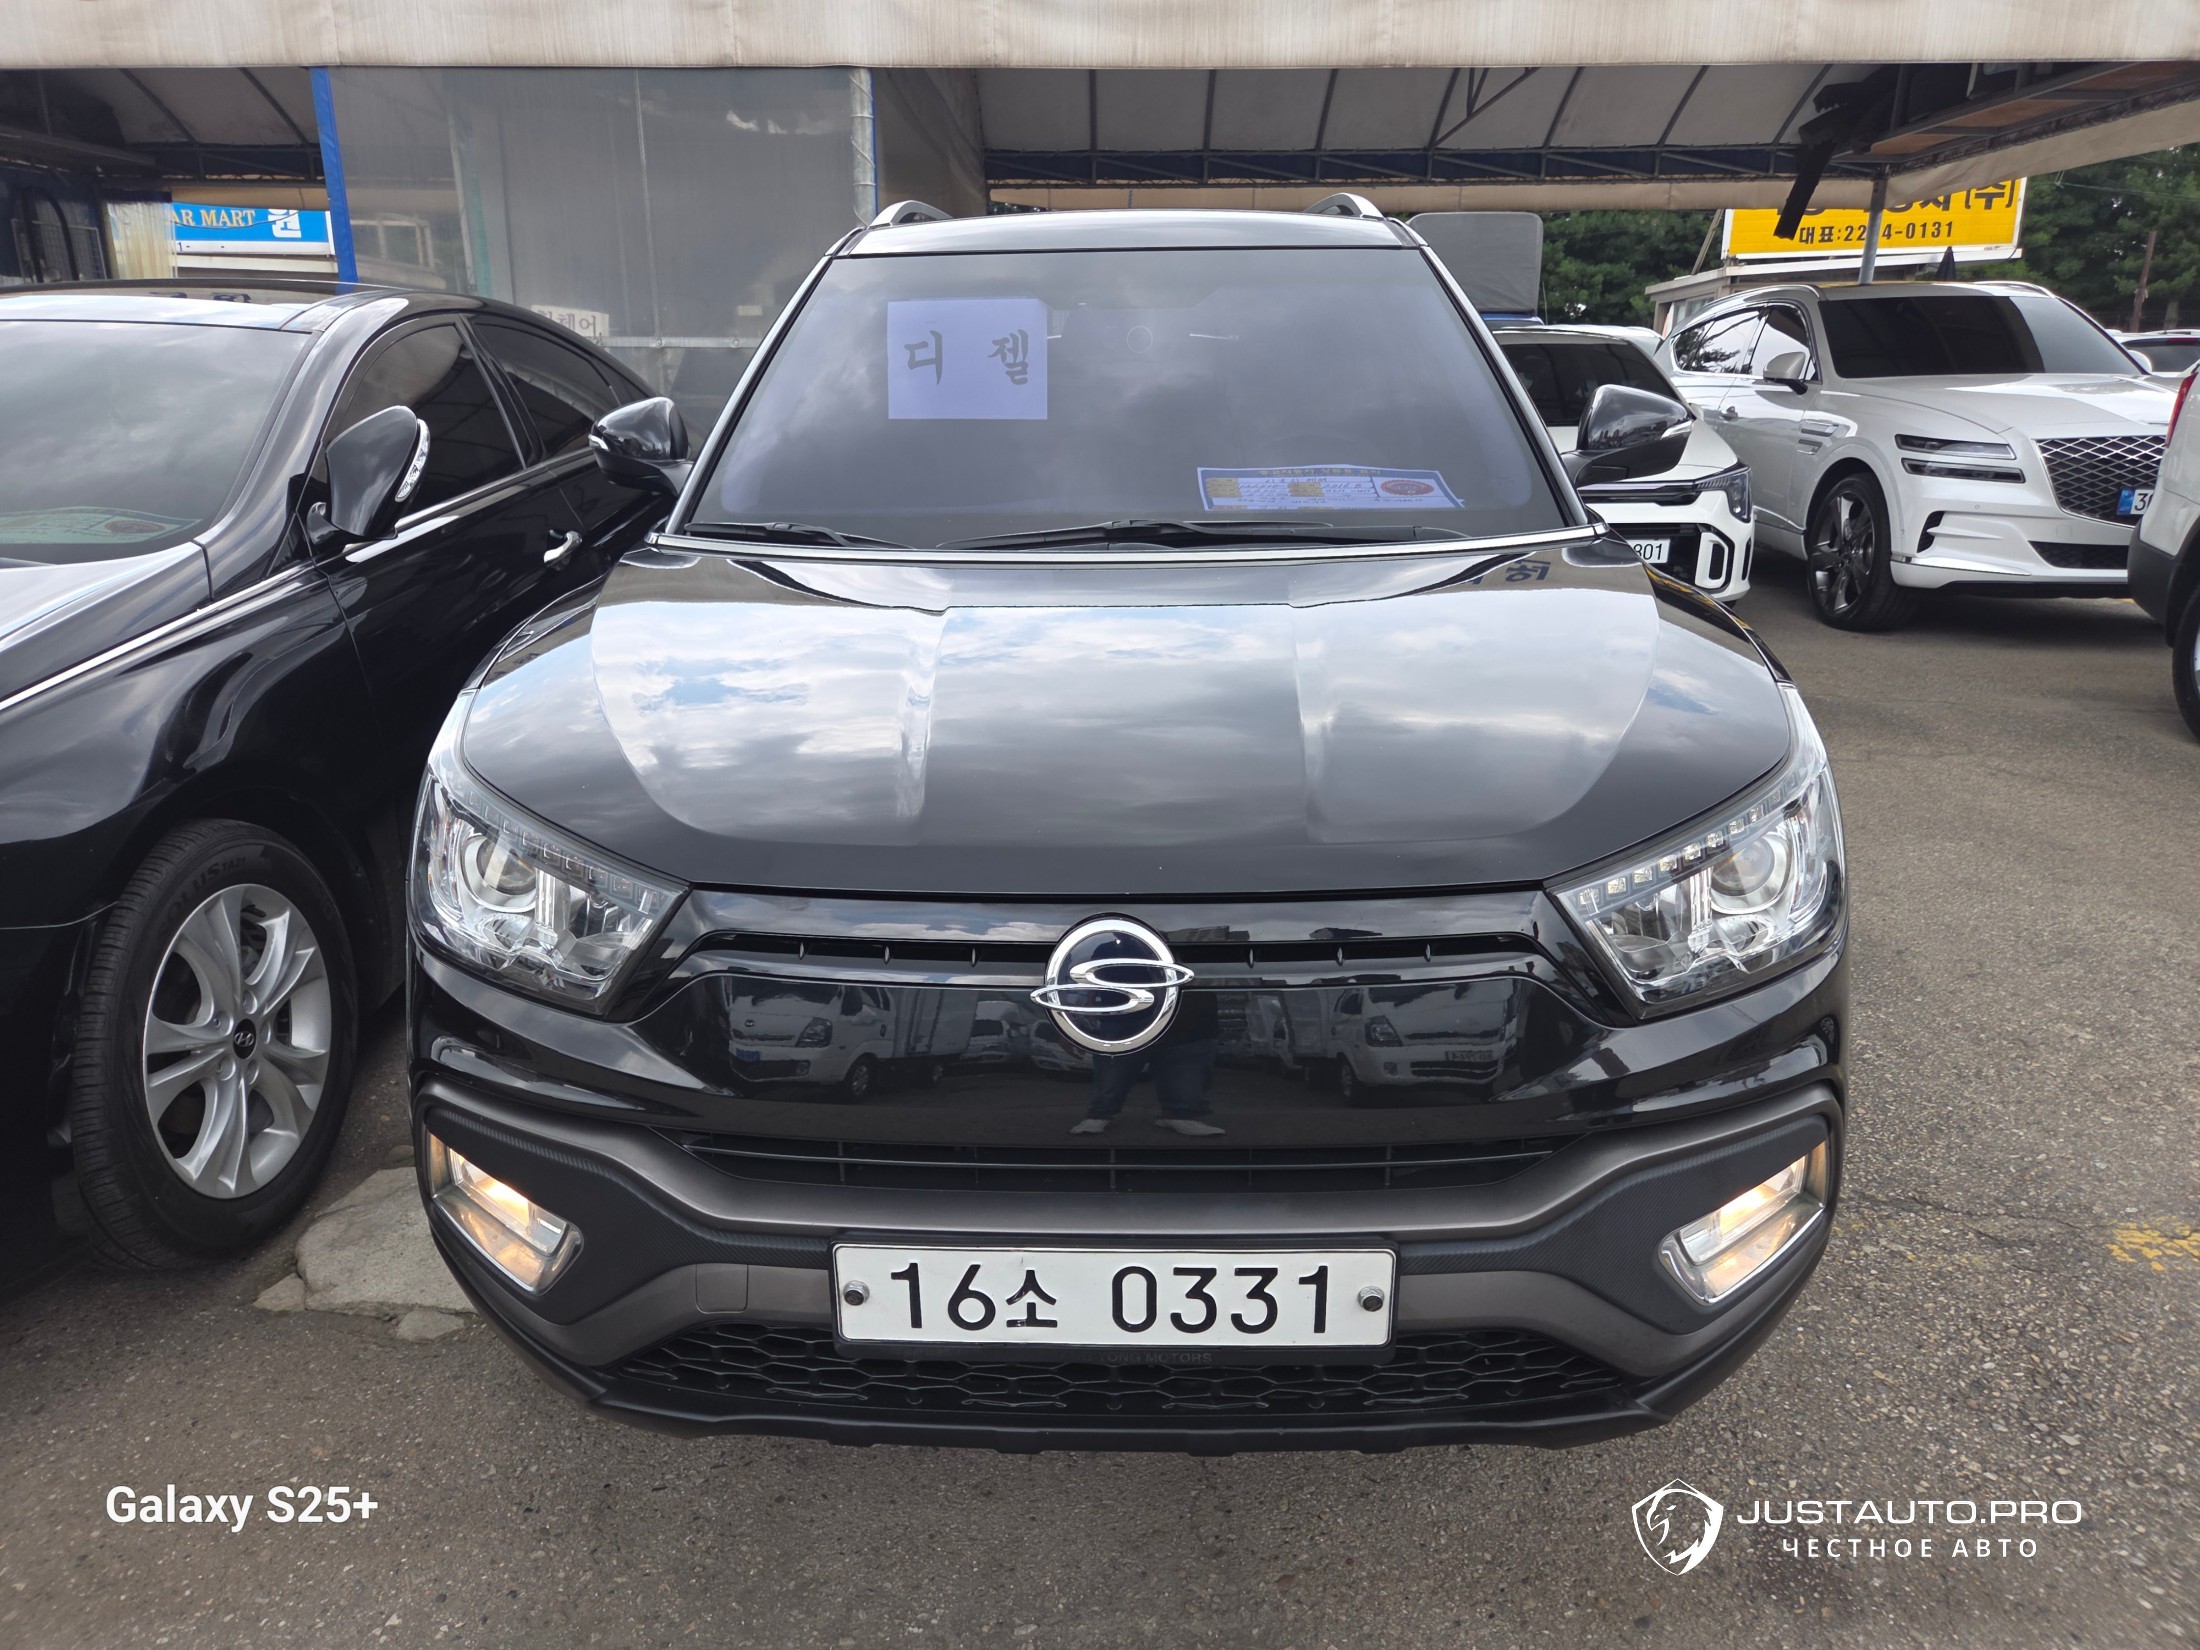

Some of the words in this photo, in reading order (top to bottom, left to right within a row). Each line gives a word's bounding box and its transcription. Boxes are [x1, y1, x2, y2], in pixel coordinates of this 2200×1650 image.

[200, 209, 256, 227] MART
[1799, 221, 1953, 244] 대표:224-0131
[890, 1262, 1058, 1331] 16소
[1111, 1265, 1329, 1334] 0331
[1145, 1352, 1213, 1364] MOTORS
